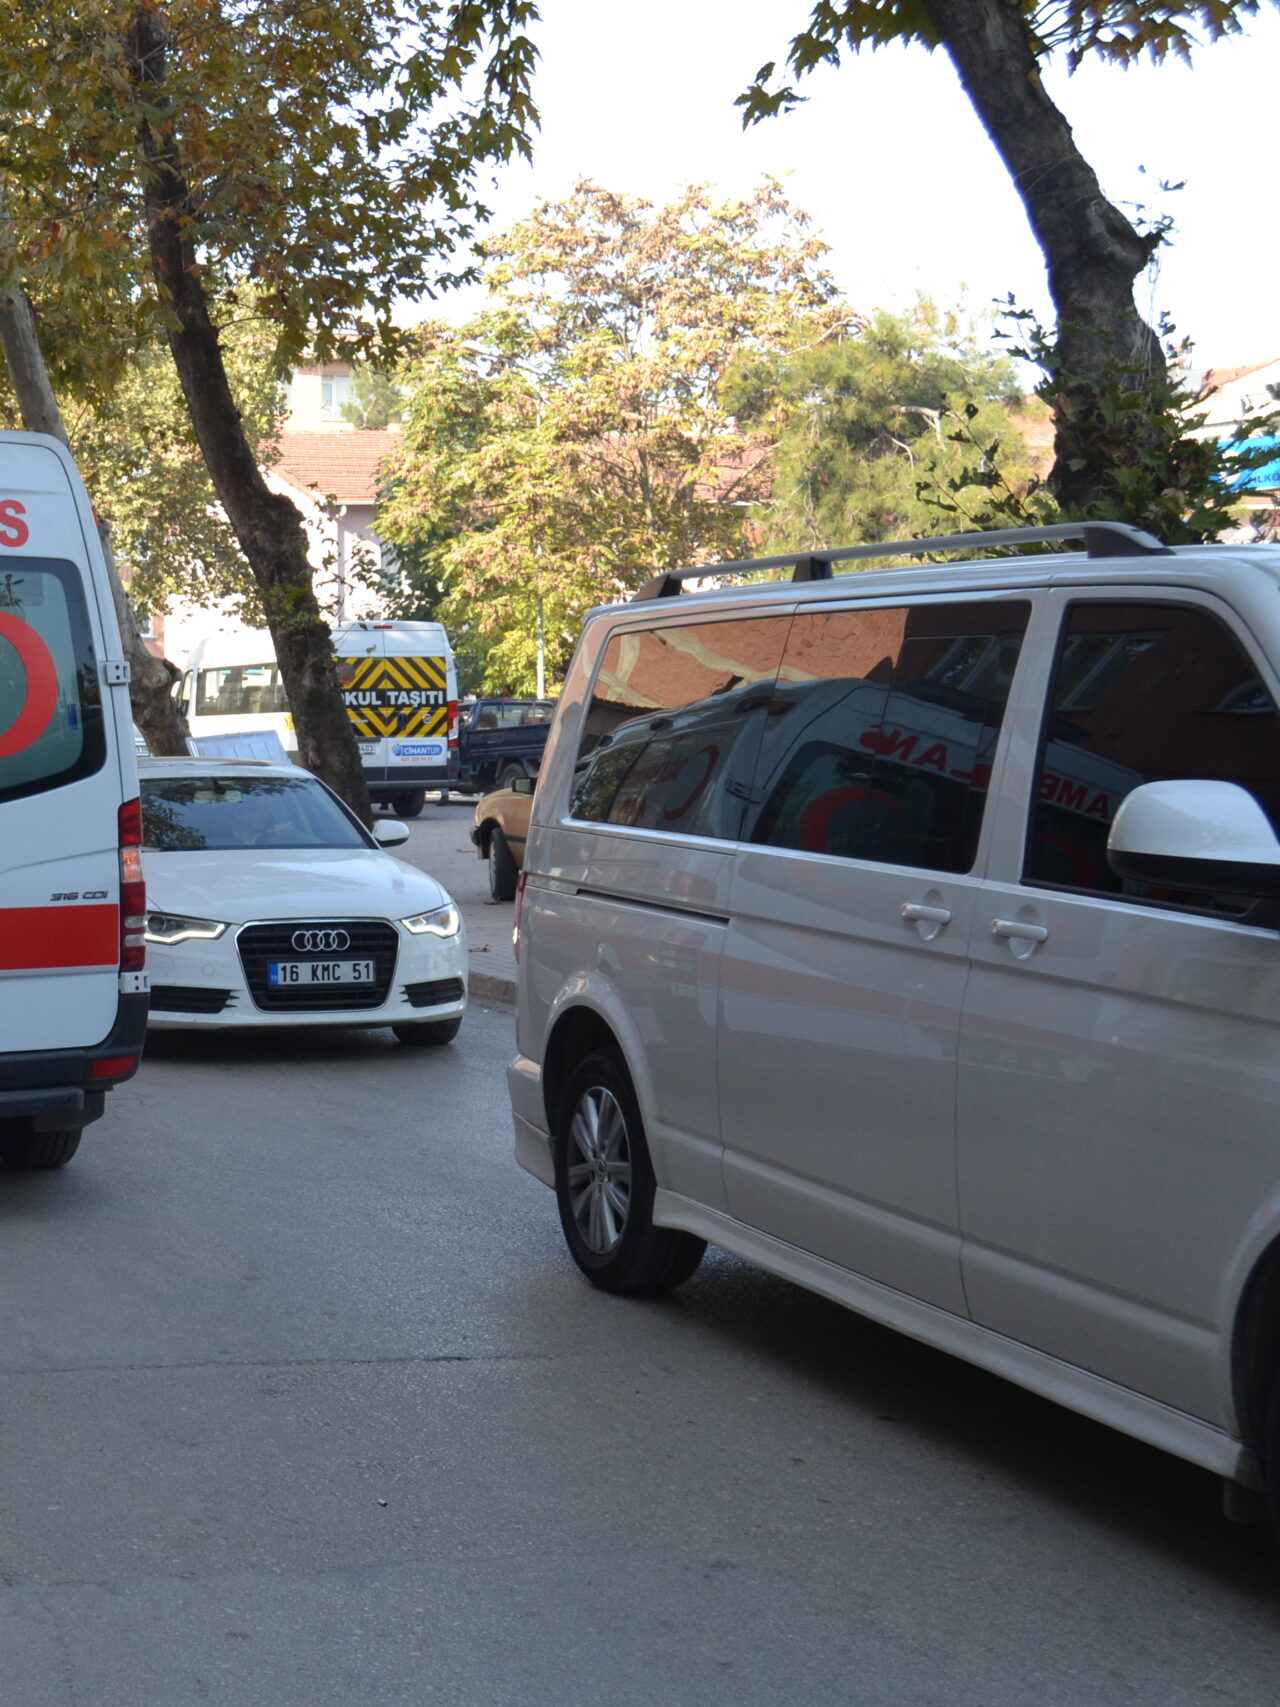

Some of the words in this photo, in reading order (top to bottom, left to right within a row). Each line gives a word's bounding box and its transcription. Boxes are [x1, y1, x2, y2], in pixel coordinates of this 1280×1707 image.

[341, 690, 382, 706] KUL
[386, 690, 444, 708] TAŞITI
[50, 891, 79, 902] 316
[82, 890, 109, 900] CDI
[280, 964, 300, 982] 16
[311, 963, 341, 982] KMC
[352, 962, 371, 981] 51
